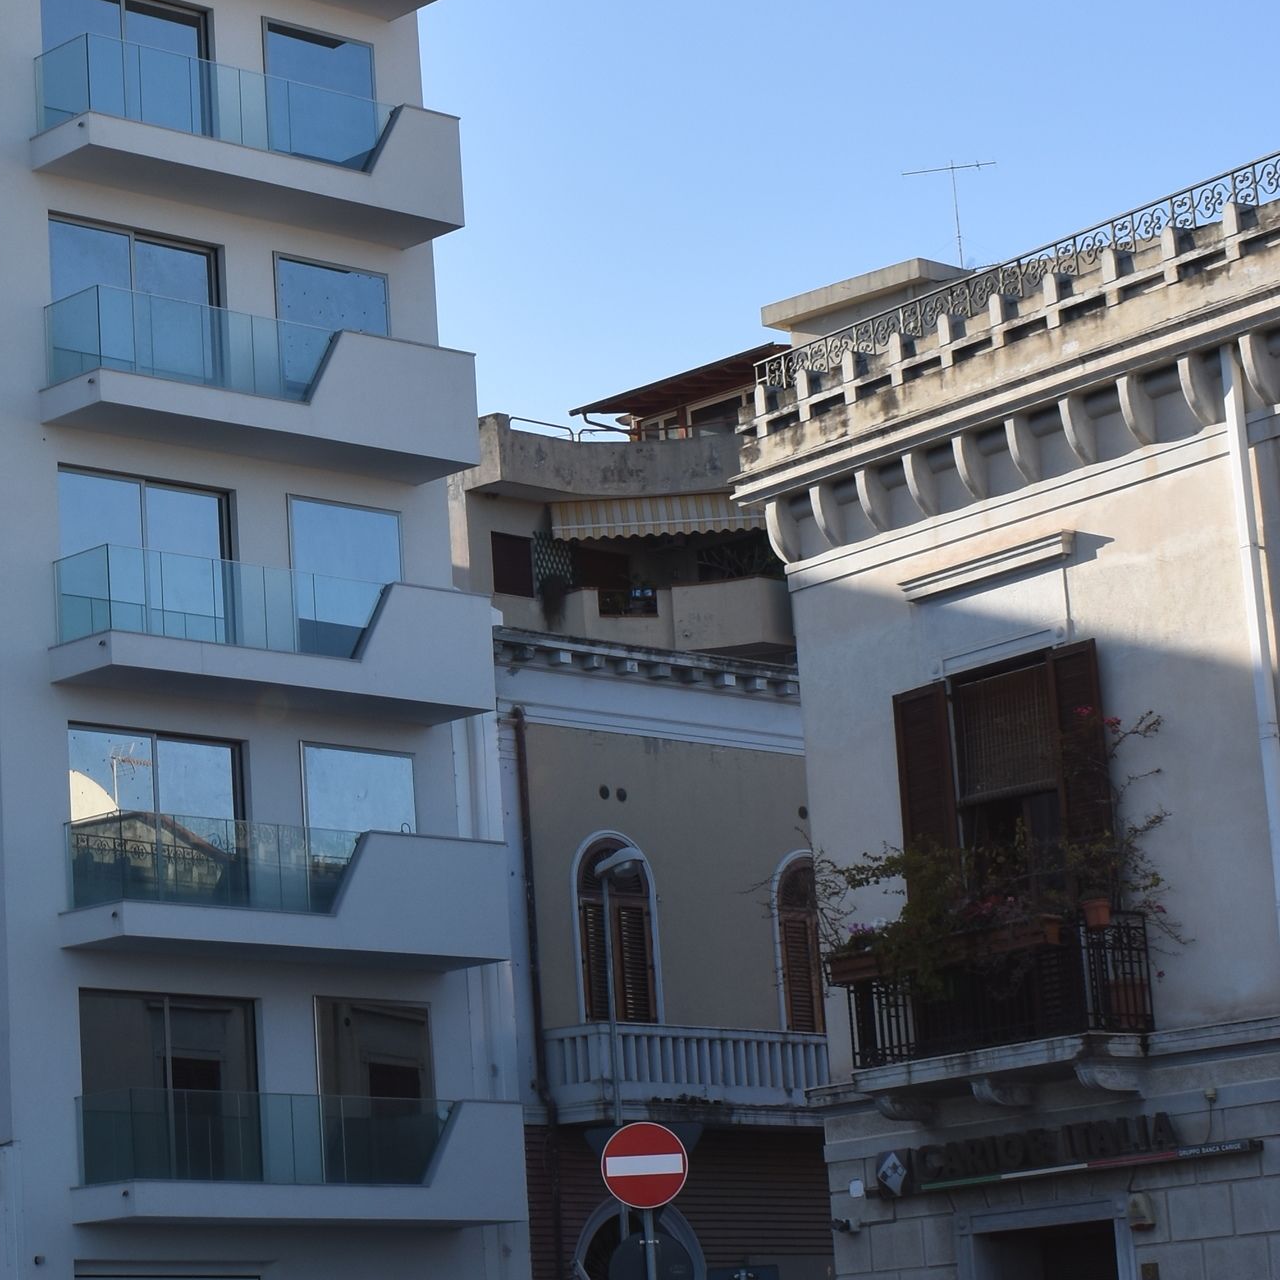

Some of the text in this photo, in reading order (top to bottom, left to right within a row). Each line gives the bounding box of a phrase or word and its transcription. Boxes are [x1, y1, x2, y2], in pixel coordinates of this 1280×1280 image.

[1061, 1111, 1177, 1160] ITALIA
[1178, 1147, 1201, 1157] GRUPPO
[1201, 1145, 1220, 1154] BANCA
